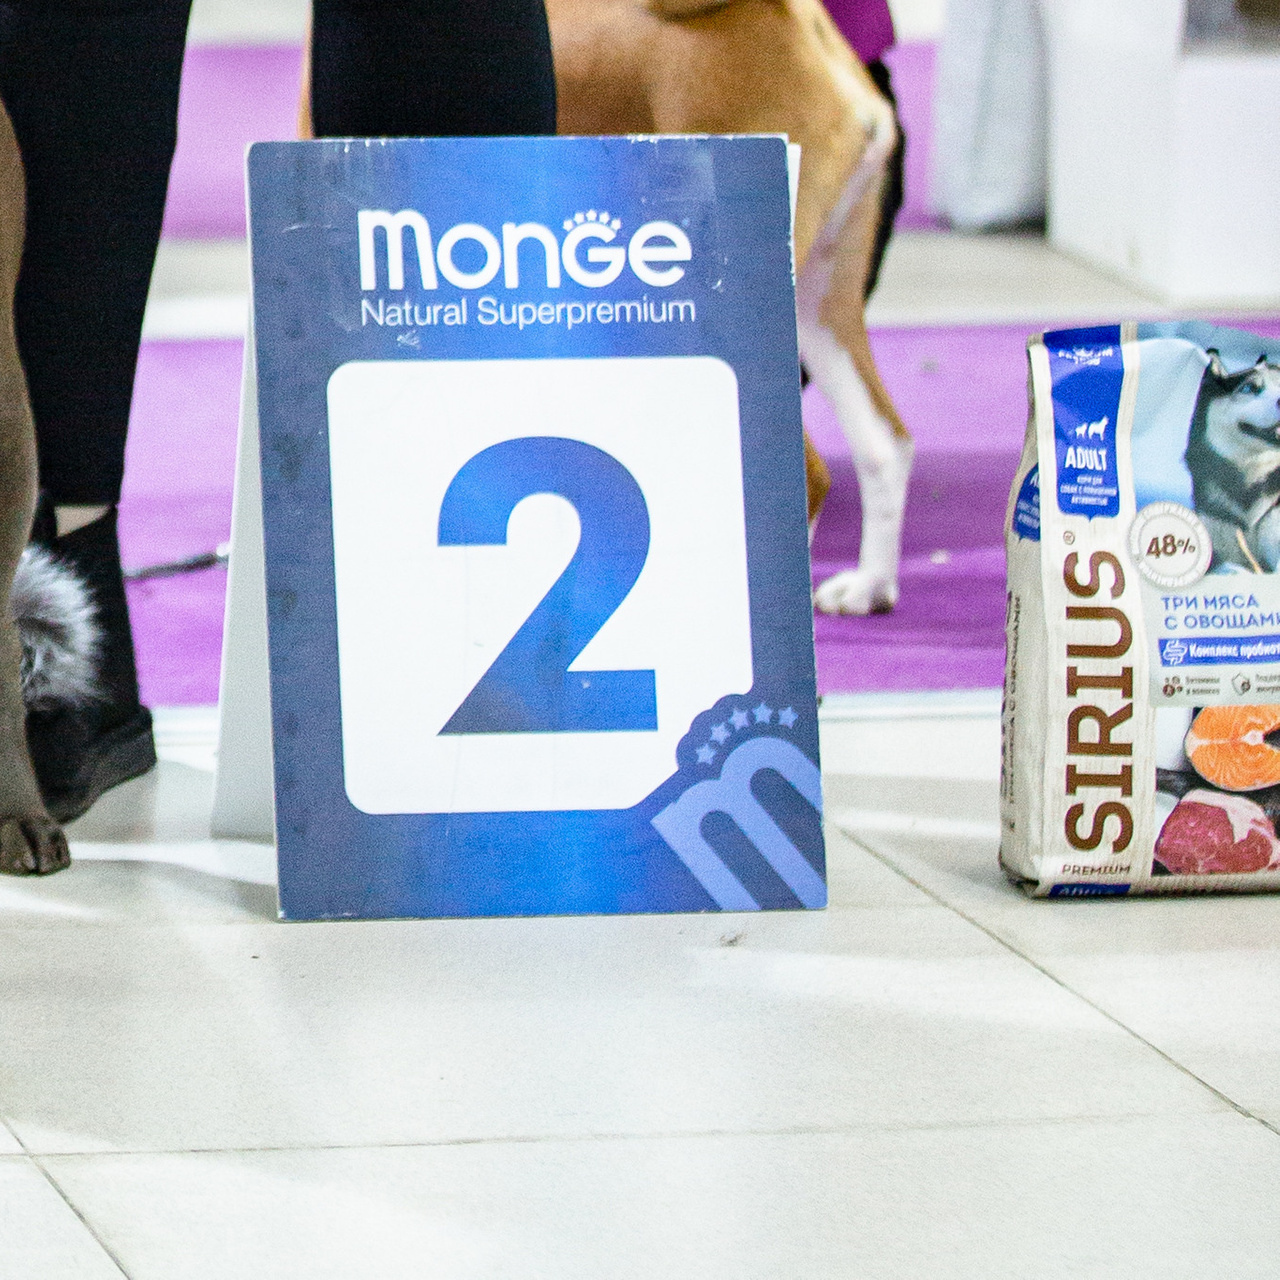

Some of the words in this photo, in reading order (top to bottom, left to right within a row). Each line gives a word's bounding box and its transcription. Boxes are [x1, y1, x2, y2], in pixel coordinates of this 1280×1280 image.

[361, 297, 468, 327] Natural
[477, 295, 697, 331] Superpremium
[1064, 446, 1107, 471] ADULT
[1146, 534, 1196, 559] 48%
[435, 435, 659, 737] 2
[1161, 595, 1198, 610] ТРИ
[1204, 593, 1260, 610] МЯСА
[1164, 615, 1178, 630] С
[1063, 550, 1134, 854] SIRIUS
[1062, 863, 1132, 876] PREMIUM
